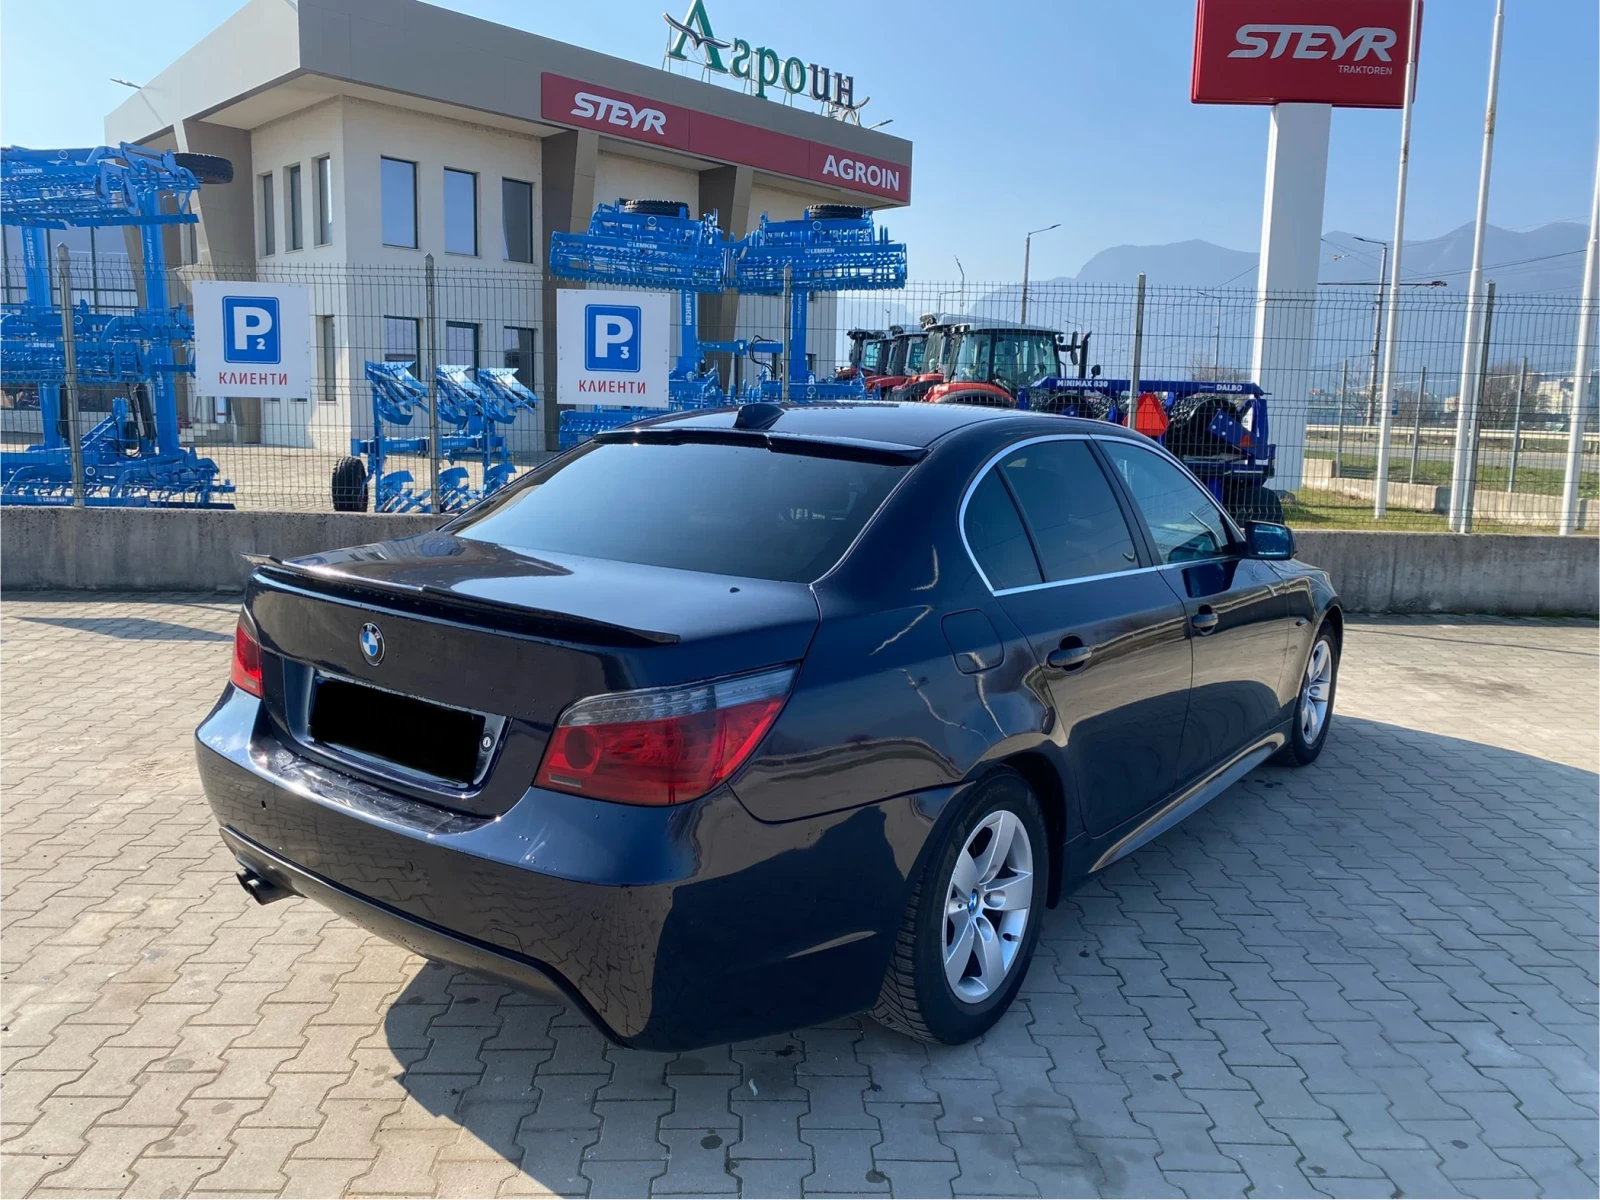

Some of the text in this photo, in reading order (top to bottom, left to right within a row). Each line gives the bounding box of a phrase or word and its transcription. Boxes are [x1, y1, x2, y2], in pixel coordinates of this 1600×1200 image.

[1227, 23, 1397, 62] STEYR
[1338, 64, 1393, 75] TRAKTOREN
[570, 91, 667, 135] STEYR
[822, 154, 900, 192] AGROIN
[632, 242, 658, 250] LEMKEN
[218, 372, 288, 386] КЛИЕНТИ
[1057, 379, 1109, 388] MINIMAX 830
[578, 379, 646, 394] КЛИЕНТИ
[1216, 384, 1243, 392] DALBO
